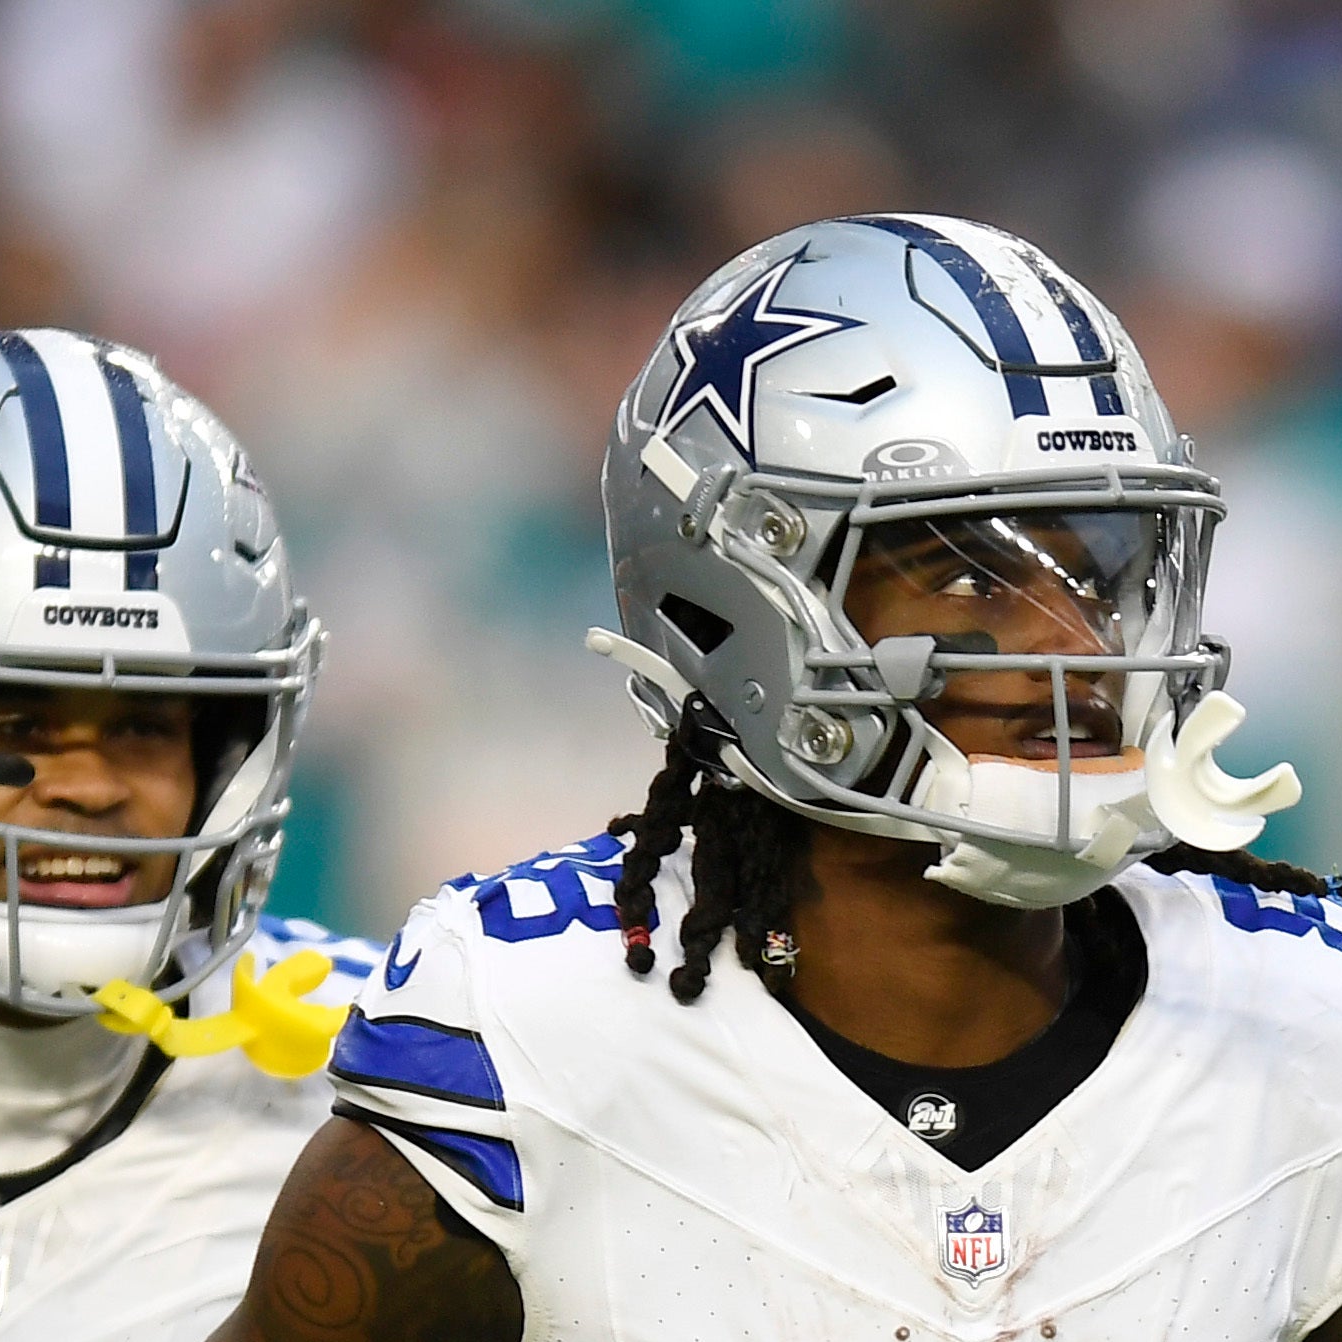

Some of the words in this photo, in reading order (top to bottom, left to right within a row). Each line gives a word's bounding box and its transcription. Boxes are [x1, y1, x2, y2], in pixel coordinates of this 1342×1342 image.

[1037, 430, 1137, 452] COWBOYS
[862, 464, 954, 482] OAKLEY
[43, 604, 159, 629] COWBOYS
[951, 1237, 998, 1270] NFL
